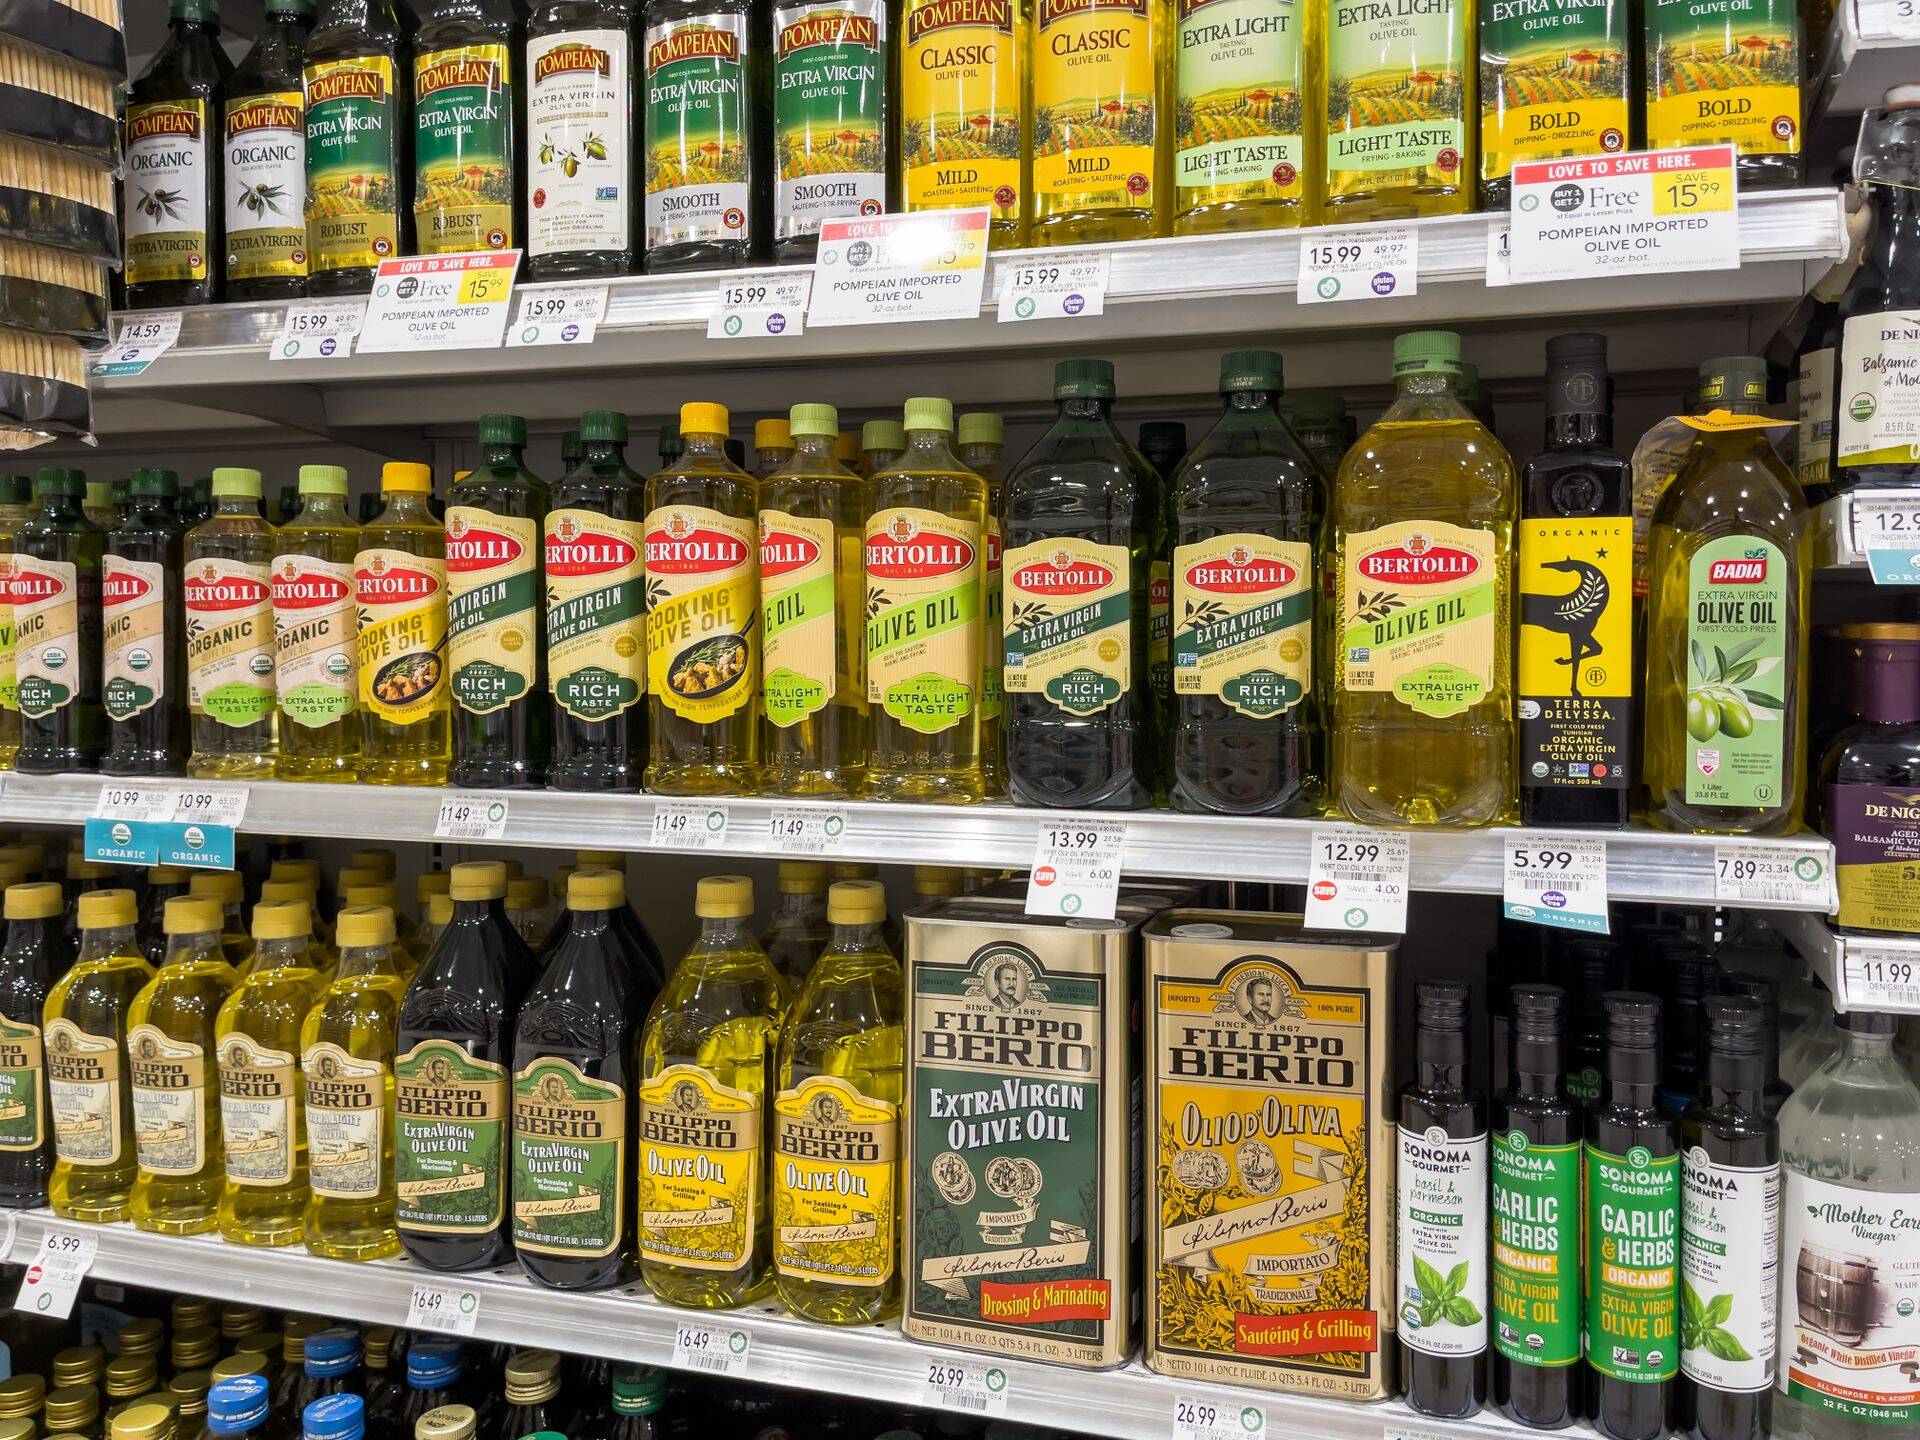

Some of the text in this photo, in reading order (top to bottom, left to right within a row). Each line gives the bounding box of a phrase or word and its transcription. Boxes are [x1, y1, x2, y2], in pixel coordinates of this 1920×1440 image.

[784, 19, 872, 50] POMPEIAN
[1182, 16, 1290, 49] EXTRA LIGHT
[1051, 28, 1130, 56] CLASSIC
[538, 52, 604, 72] POMPEIAN
[782, 65, 875, 89] EXTRA VIRGIN
[131, 113, 195, 139] POMPEIAN
[1529, 111, 1581, 132] BOLD
[434, 125, 474, 138] OLIVE OIL
[1552, 129, 1596, 139] DRIZZLING
[1338, 130, 1452, 156] LIGHT TASTE
[231, 146, 296, 165] ORGANIC
[1396, 150, 1426, 159] BAKING
[1067, 157, 1111, 174] MILD
[1548, 154, 1696, 178] LOVE TO SAVE HERE.
[1053, 177, 1085, 187] ROASTING
[1675, 172, 1708, 183] SAVE
[794, 183, 857, 201] SMOOTH
[1590, 187, 1639, 208] Free
[1614, 208, 1633, 216] Price
[320, 222, 368, 238] ROBUST
[1538, 218, 1708, 240] POMPEIAN IMPORTED
[1584, 238, 1661, 253] OLIVE OIL
[1310, 246, 1361, 264] 15.99
[1595, 256, 1626, 264] 32-oz
[400, 257, 493, 272] LOVE TO SAVE HERE.
[833, 273, 961, 291] POMPEIAN IMPORTED
[1014, 268, 1059, 285] 15.99
[526, 300, 565, 315] 15.99
[1064, 299, 1084, 308] gluten
[126, 324, 161, 339] 14.59
[1863, 354, 1916, 373] Balsamic
[646, 543, 738, 562] BERTOLLI
[867, 546, 962, 565] BERTOLLI
[1368, 556, 1468, 574] BERTOLLI
[1713, 564, 1762, 578] BADIA
[1020, 571, 1104, 587] BERTOLLI
[1195, 569, 1287, 585] BERTOLLI
[1698, 591, 1777, 600] EXTRA VIRGIN
[649, 589, 730, 635] COOKING
[1698, 602, 1776, 624] OLIVE OIL
[869, 596, 958, 652] OLIVE OIL
[1023, 603, 1101, 643] EXTRA VIRGIN
[1375, 598, 1466, 645] OLIVE OIL
[189, 621, 252, 658] ORGANIC
[21, 689, 51, 698] RICH
[1062, 683, 1104, 694] RICH
[1554, 700, 1601, 709] TERRA
[1545, 710, 1612, 719] DELYSSA
[1577, 745, 1616, 753] VIRGIN
[1050, 832, 1097, 848] 13.99
[1855, 834, 1904, 845] BALSAMIC
[98, 848, 145, 860] ORGANIC
[172, 852, 221, 863] ORGANIC
[1325, 845, 1379, 862] 12.99
[1514, 851, 1572, 868] 5.99
[1090, 869, 1112, 879] 6.00
[1718, 860, 1789, 879] 7.89 23.34
[1375, 885, 1399, 894] 4.00
[1864, 963, 1911, 983] 11.99
[965, 1004, 994, 1012] SINCE
[935, 1011, 1082, 1040] FILIPPO
[1183, 1028, 1343, 1056] FILIPPO
[922, 1031, 1091, 1072] BERIO
[1169, 1048, 1354, 1088] BERIO
[402, 1087, 481, 1100] FILIPPO
[398, 1097, 487, 1117] BERIO
[649, 1111, 732, 1130] FILIPPO
[643, 1122, 737, 1148] BERIO
[1404, 1142, 1471, 1162] SONOMA
[648, 1148, 726, 1184] OLIVE OIL
[1412, 1161, 1461, 1173] GOURMET
[1600, 1164, 1673, 1184] SONOMA
[986, 1213, 1027, 1223] IMPORTED
[1413, 1212, 1458, 1225] ORGANIC
[1602, 1204, 1674, 1236] GARLIC
[1820, 1204, 1886, 1227] Mother
[48, 1236, 80, 1252] 6.99
[1852, 1225, 1896, 1245] Vinegar
[1602, 1237, 1674, 1266] & HERBS
[1257, 1253, 1329, 1271] IMPORTATO
[984, 1284, 1107, 1316] Dressing & Marinating
[1256, 1290, 1312, 1300] TRADIZIONALE
[922, 1325, 986, 1343] NET 101.4 FL OZ
[1239, 1320, 1372, 1344] Sautéing Grilling
[1602, 1311, 1674, 1339] OLIVE OIL
[1801, 1334, 1916, 1366] Organic White Distilled Vinegar
[929, 1366, 963, 1386] 26.99
[1817, 1382, 1868, 1399] ALL PURPOSE
[1823, 1399, 1908, 1418] 32 FL OZ (946 mL)
